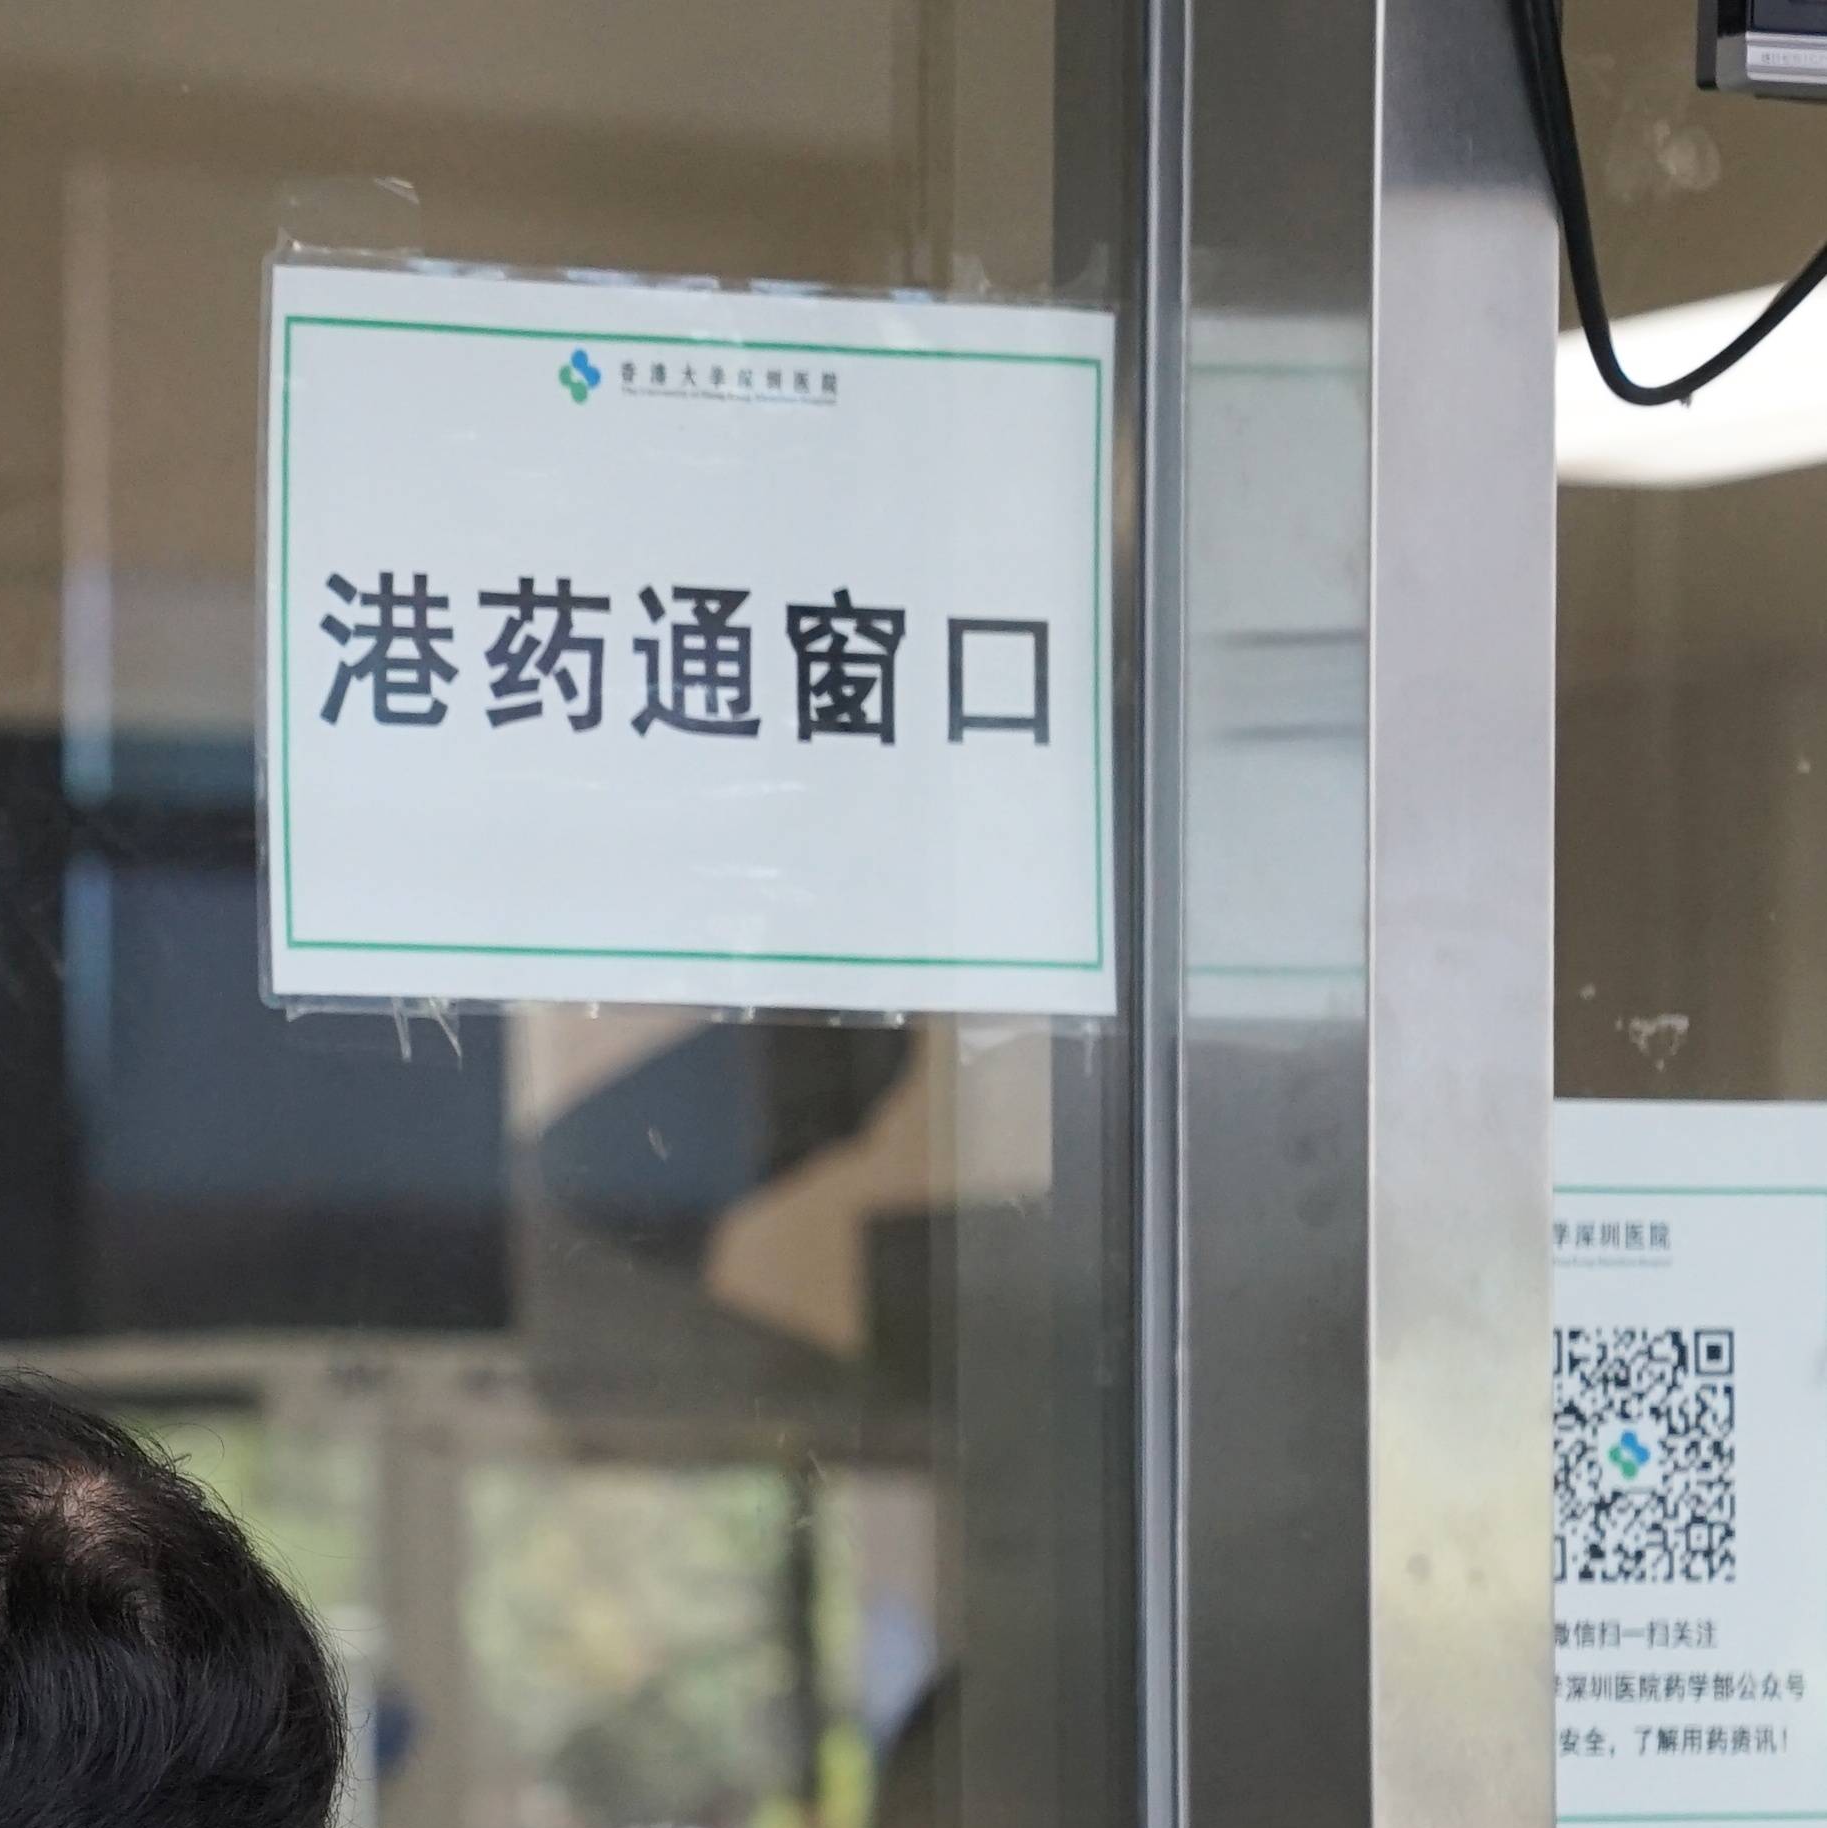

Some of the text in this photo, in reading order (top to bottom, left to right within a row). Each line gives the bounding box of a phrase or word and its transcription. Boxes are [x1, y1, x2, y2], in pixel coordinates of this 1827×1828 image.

[319, 571, 1051, 746] 港药通窗口
[1554, 1671, 1805, 1703] 深圳医院药学部公众号
